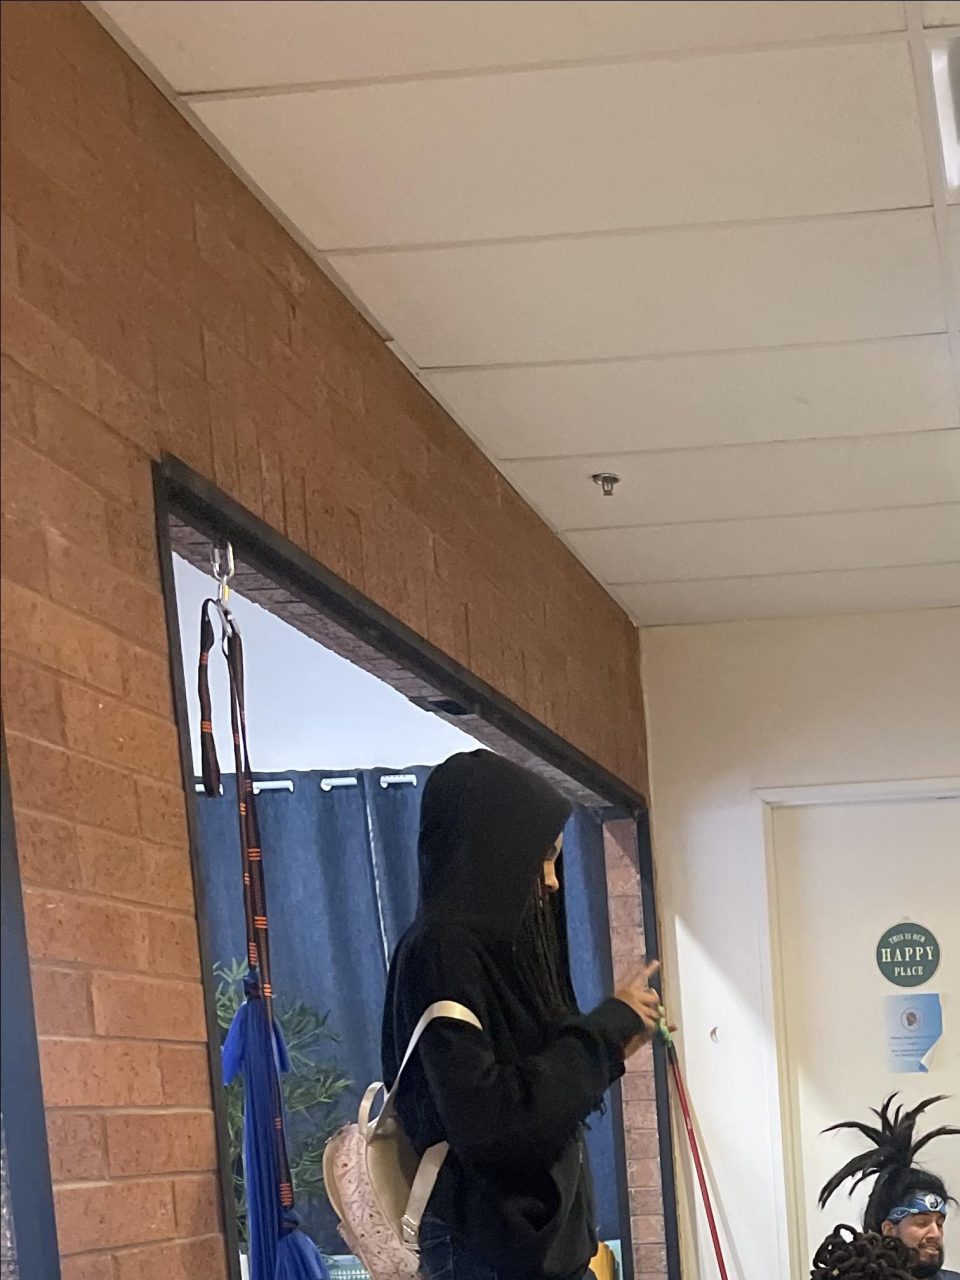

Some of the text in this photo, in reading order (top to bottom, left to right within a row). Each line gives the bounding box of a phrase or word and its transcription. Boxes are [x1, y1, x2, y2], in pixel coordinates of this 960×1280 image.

[888, 932, 926, 944] THIS IS OUR
[881, 946, 934, 962] HAPPY
[894, 966, 924, 976] PLACE
